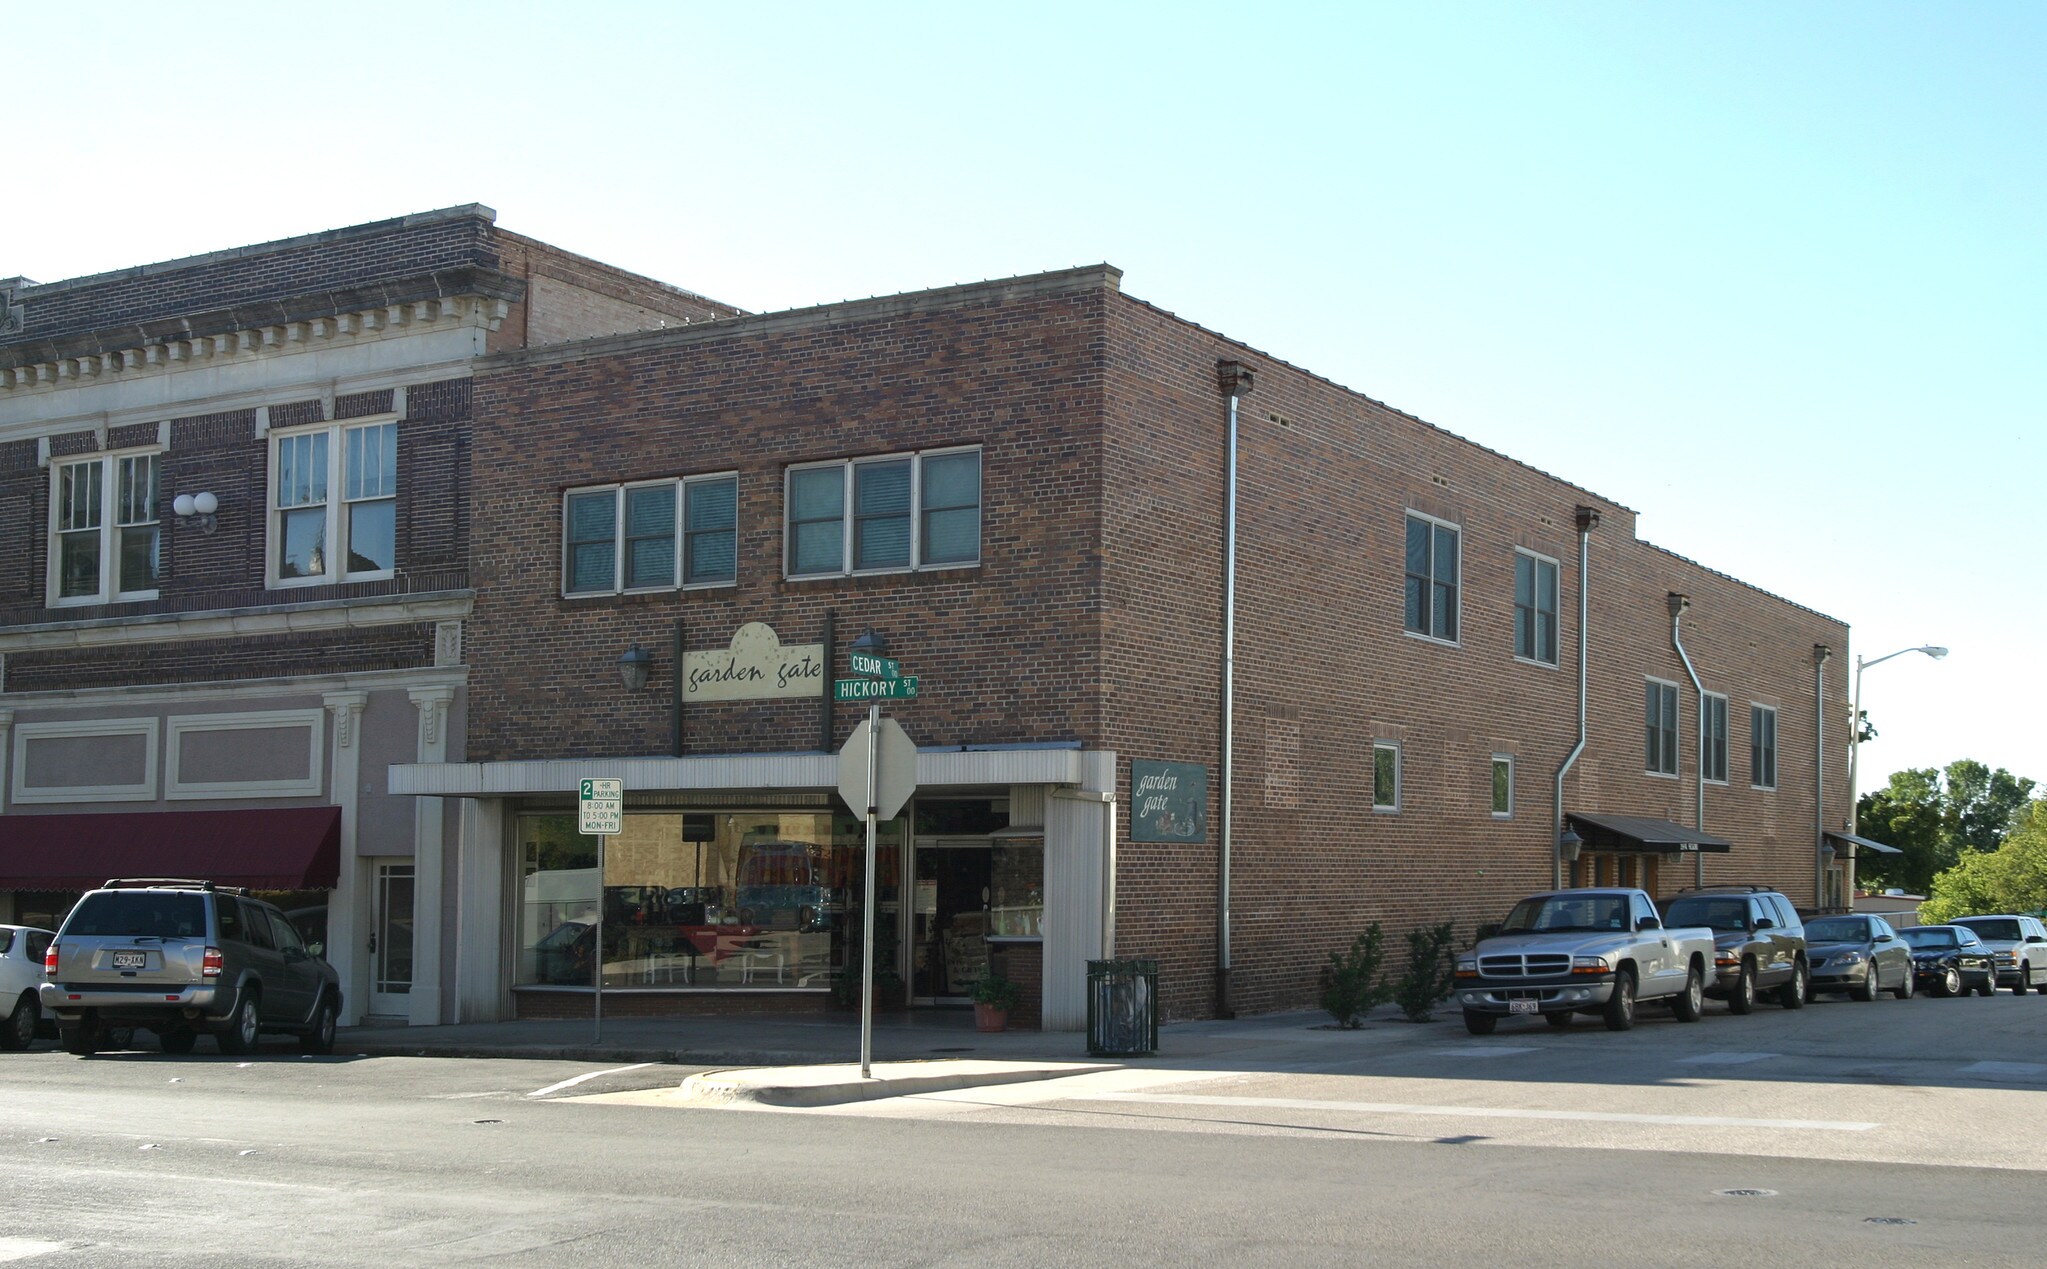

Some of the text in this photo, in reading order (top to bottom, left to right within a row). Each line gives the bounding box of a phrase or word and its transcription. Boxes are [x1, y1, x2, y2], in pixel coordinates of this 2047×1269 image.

[852, 655, 895, 675] CEDAR ST
[688, 654, 822, 693] garden gate
[841, 679, 912, 697] HICKORY ST
[583, 781, 591, 795] 2
[1135, 768, 1178, 797] garden
[593, 790, 620, 798] PARKING
[587, 801, 615, 810] 8:00 AM
[1139, 794, 1169, 818] gate
[583, 811, 619, 820] TO 5:00 PM
[585, 821, 616, 830] MON-FRI
